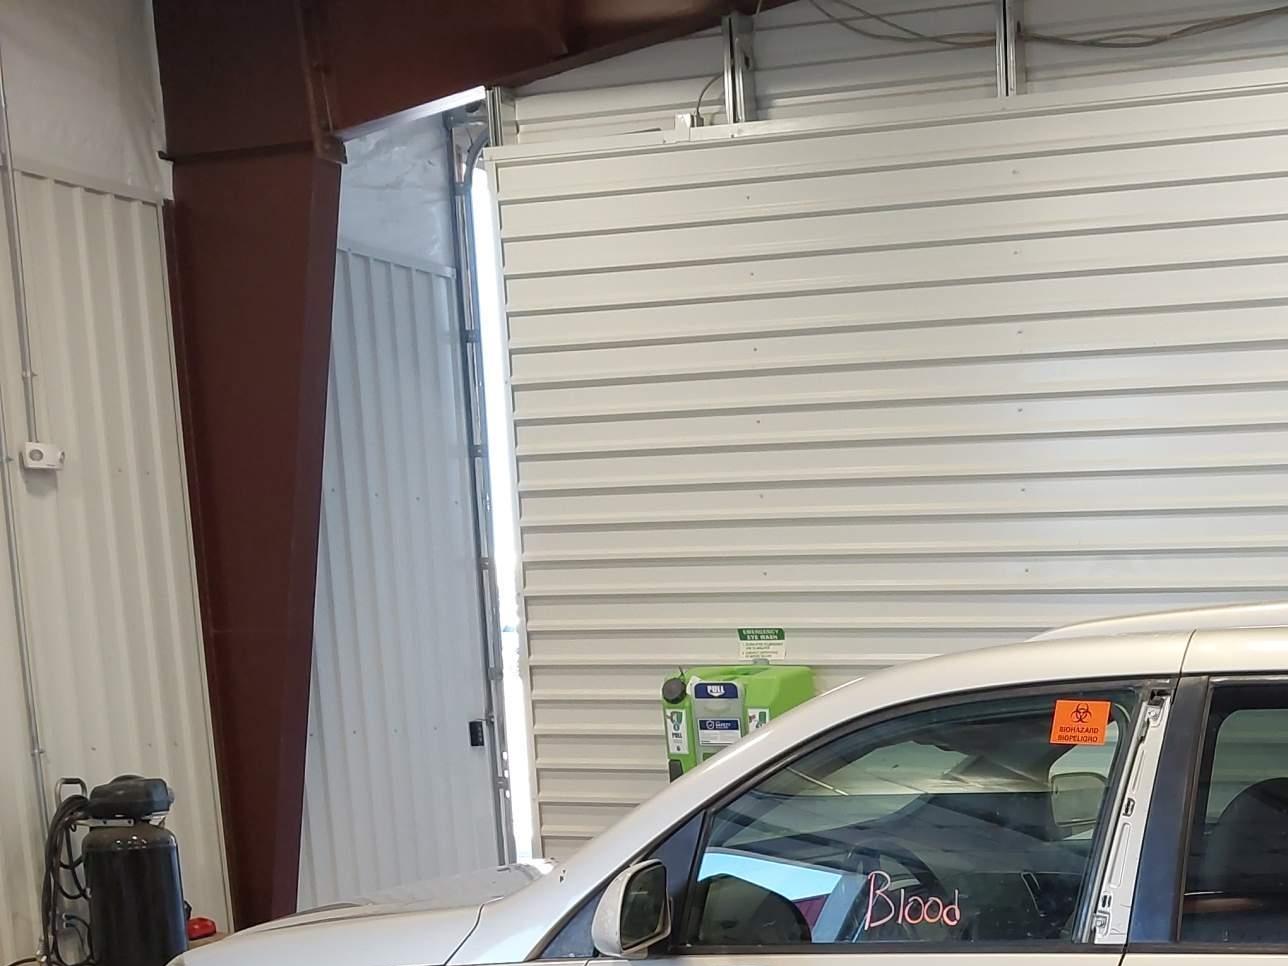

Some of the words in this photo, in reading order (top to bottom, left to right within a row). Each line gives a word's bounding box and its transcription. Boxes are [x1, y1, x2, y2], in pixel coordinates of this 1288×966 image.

[706, 685, 725, 693] PULL
[1059, 726, 1099, 734] BIOHAZARD
[1057, 734, 1098, 742] BIOPELIGRO
[864, 870, 961, 930] Blood
